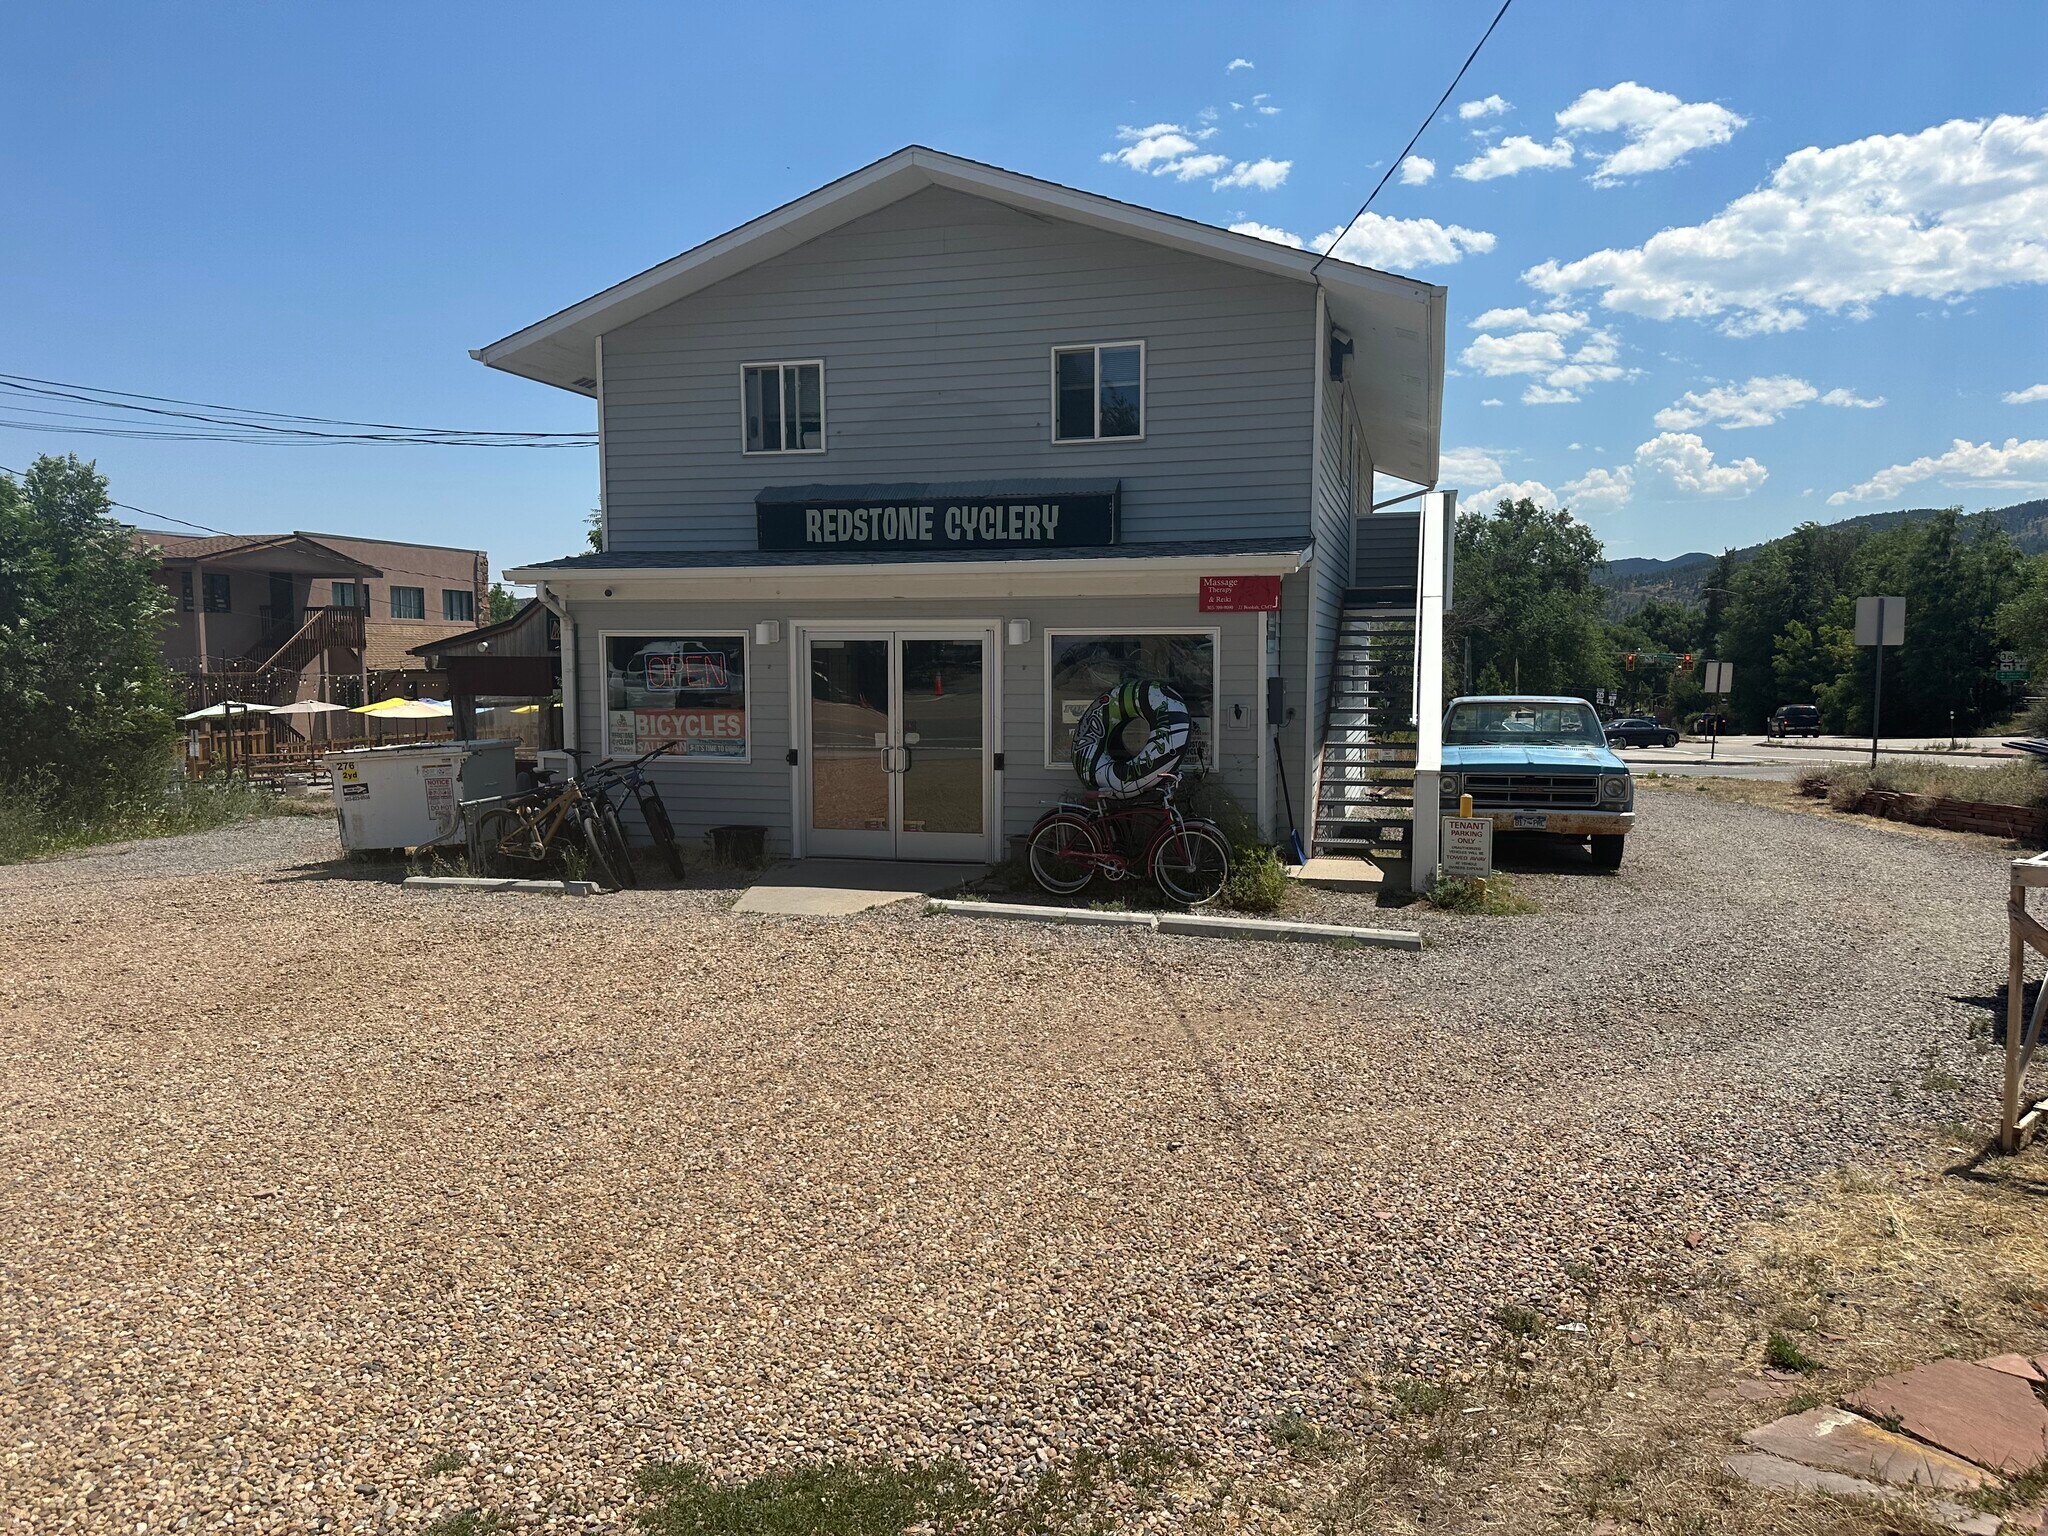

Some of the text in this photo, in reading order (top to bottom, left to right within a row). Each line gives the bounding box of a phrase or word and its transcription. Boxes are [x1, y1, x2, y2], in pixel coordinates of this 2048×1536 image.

[805, 504, 1060, 543] REDSTONE CYCLERY
[1203, 578, 1238, 587] Massage
[1208, 586, 1232, 594] Therapy
[648, 655, 725, 688] OPEN
[635, 714, 741, 736] BICYCLES
[718, 744, 725, 752] TO
[336, 762, 355, 771] 276
[342, 771, 358, 780] 2yd
[1449, 821, 1485, 830] TENANT
